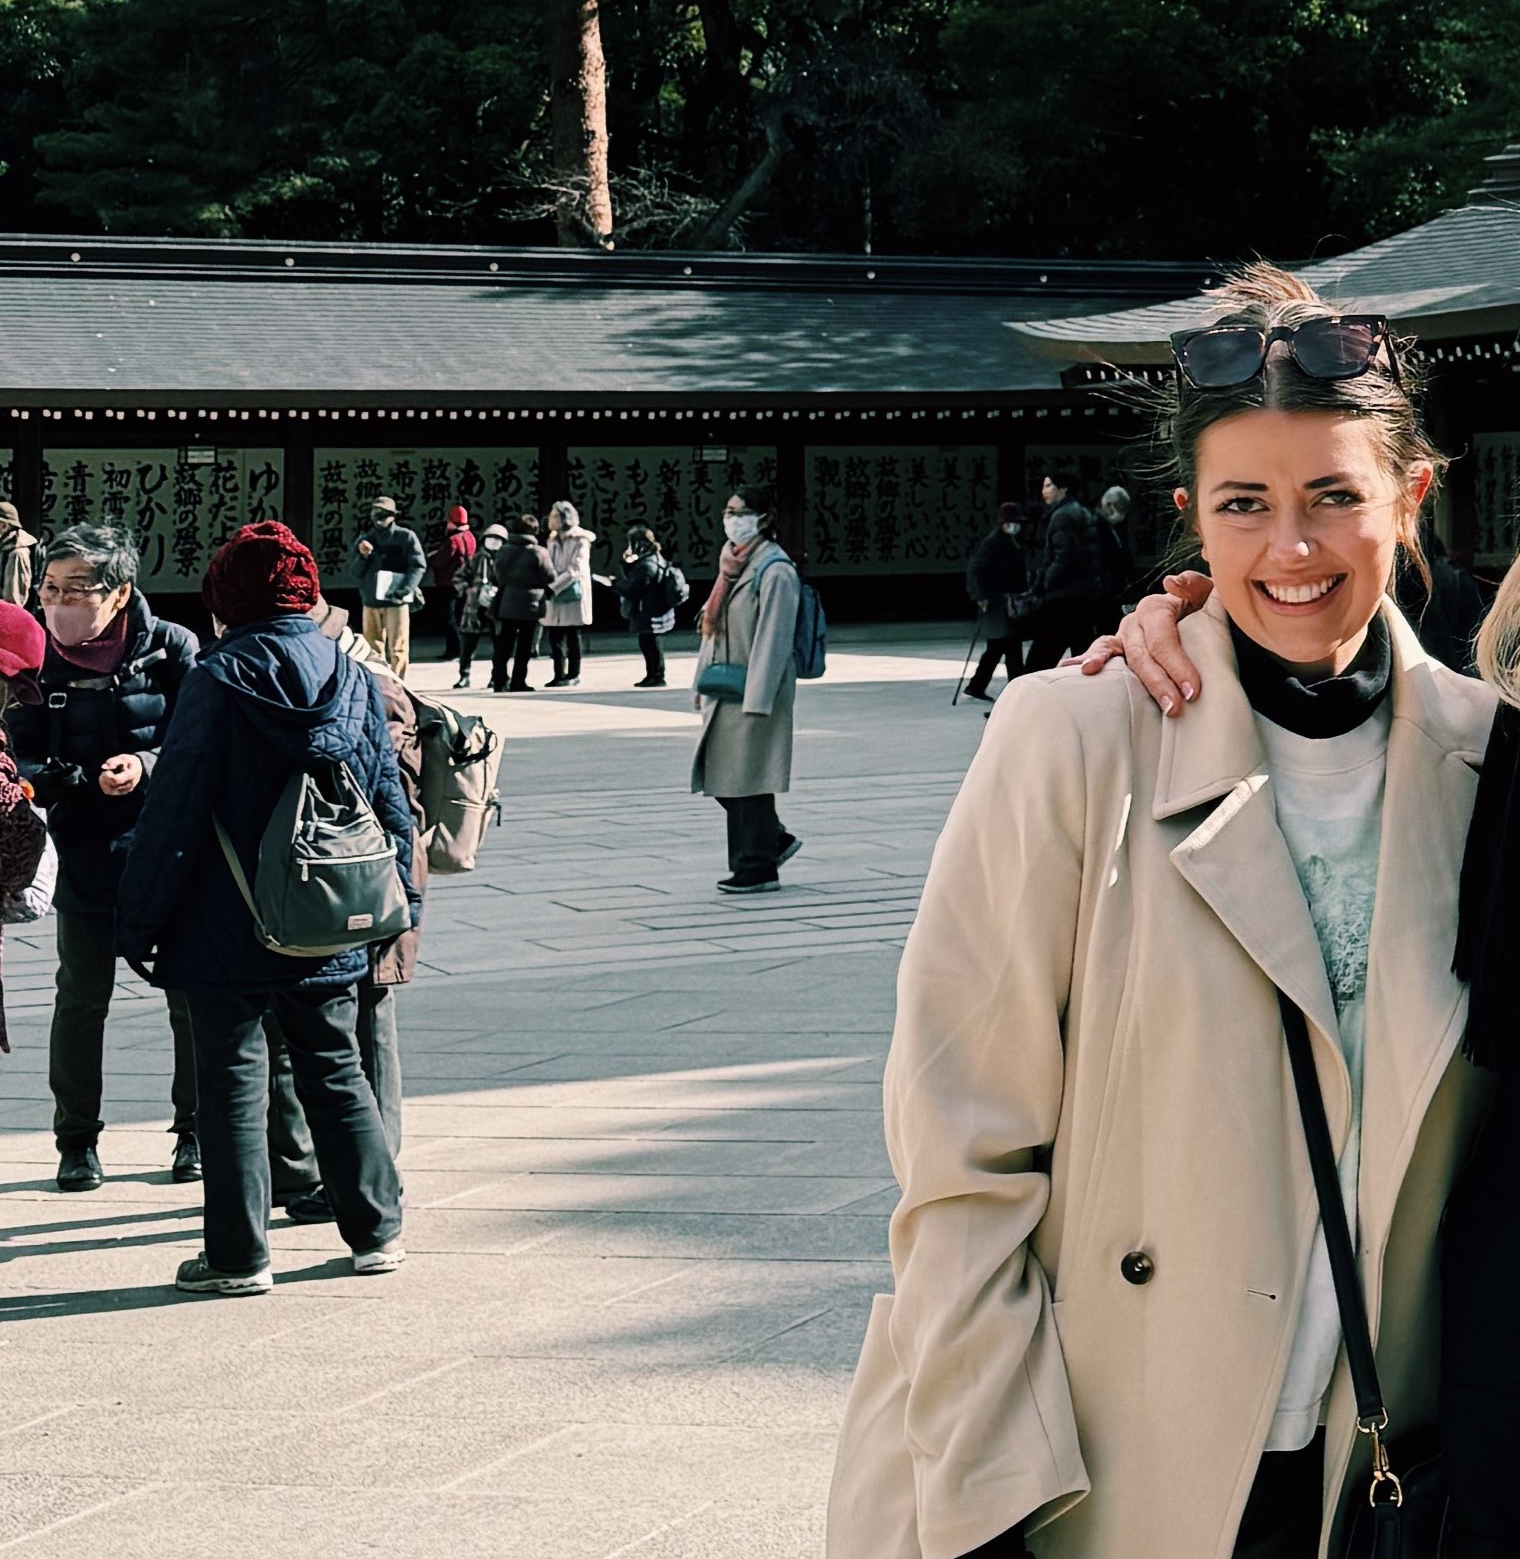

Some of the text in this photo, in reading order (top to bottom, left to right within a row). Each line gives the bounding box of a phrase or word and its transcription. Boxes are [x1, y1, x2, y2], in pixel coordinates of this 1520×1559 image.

[137, 463, 168, 576] ひかり
[173, 465, 203, 577] 故郷の風景
[319, 460, 348, 576] 故郷の風景
[591, 458, 620, 568] きぼう
[688, 461, 714, 568] 美しい空
[814, 456, 841, 564] 親しい友
[844, 456, 871, 564] 故郷の風景
[875, 456, 901, 563] 故郷の風景
[904, 456, 930, 559] 美しい心
[935, 456, 963, 561] 美しい心
